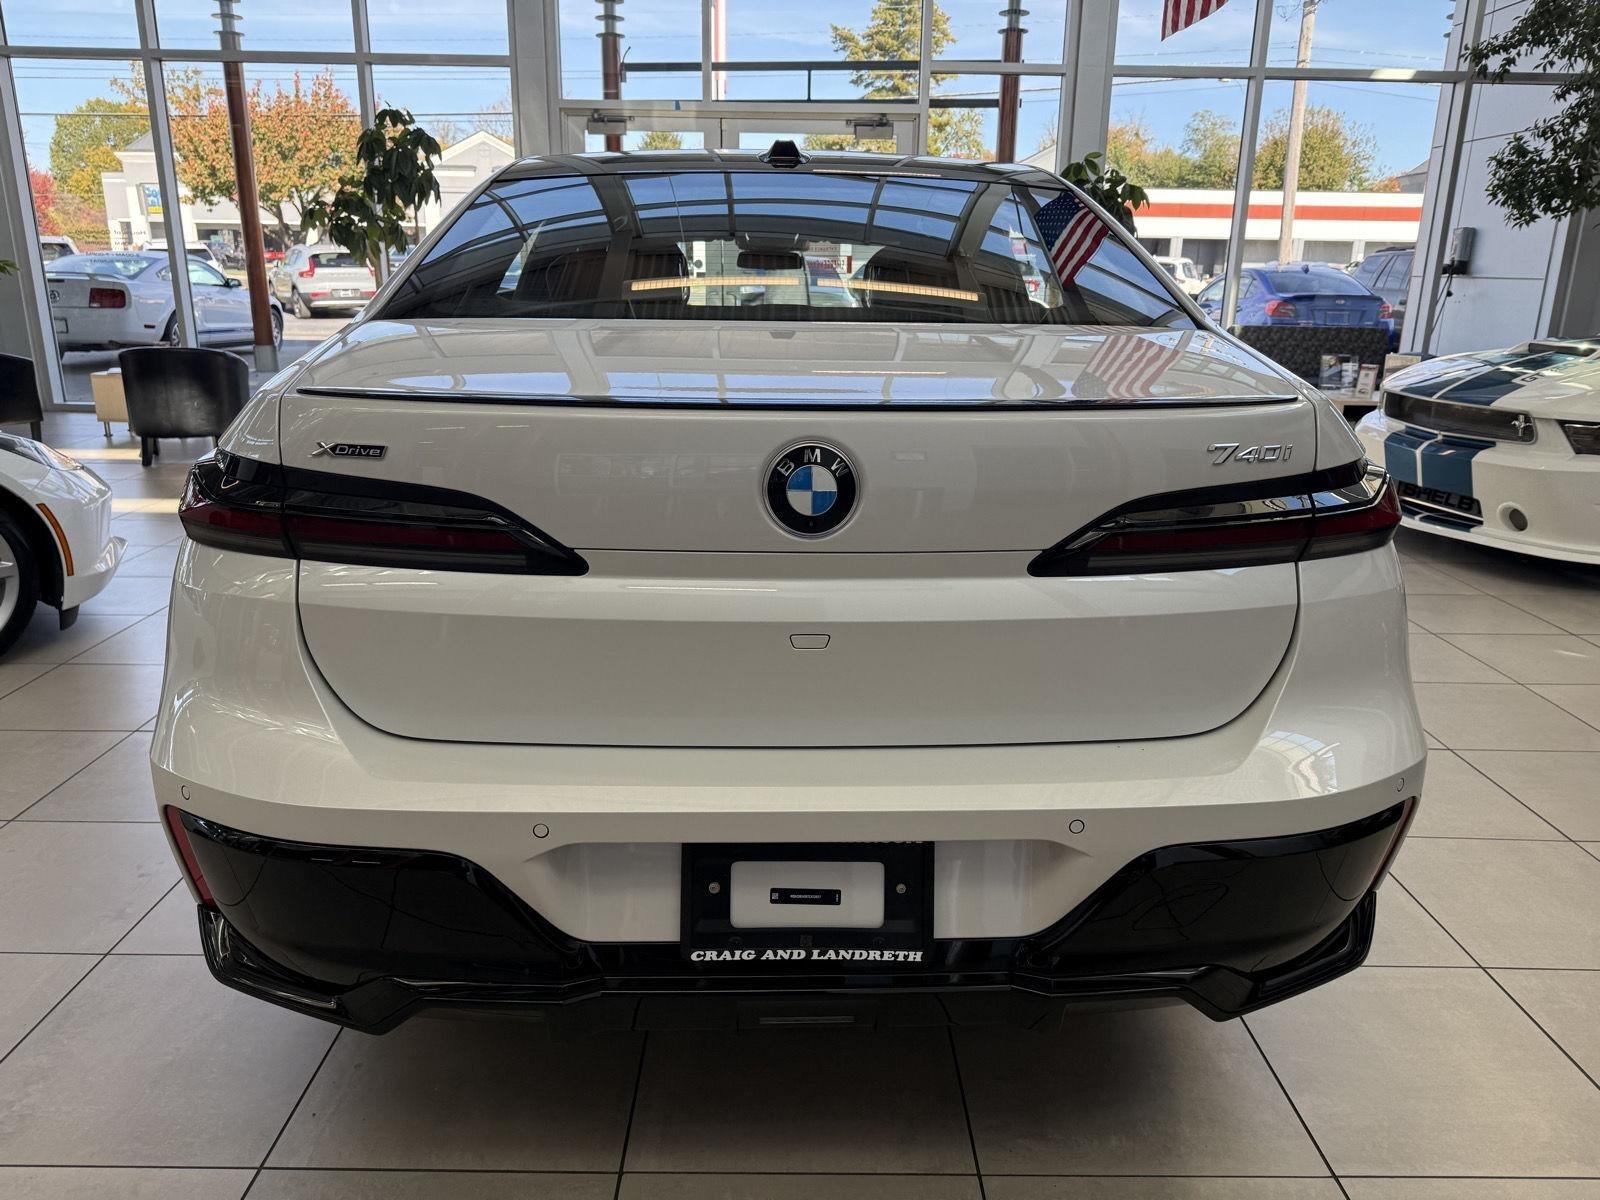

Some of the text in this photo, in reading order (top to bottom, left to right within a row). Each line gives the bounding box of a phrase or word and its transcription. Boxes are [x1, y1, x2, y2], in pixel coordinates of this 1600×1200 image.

[777, 448, 849, 477] BMW
[1207, 442, 1293, 465] 740i
[690, 949, 924, 962] CRAIG AND LANDRETH
